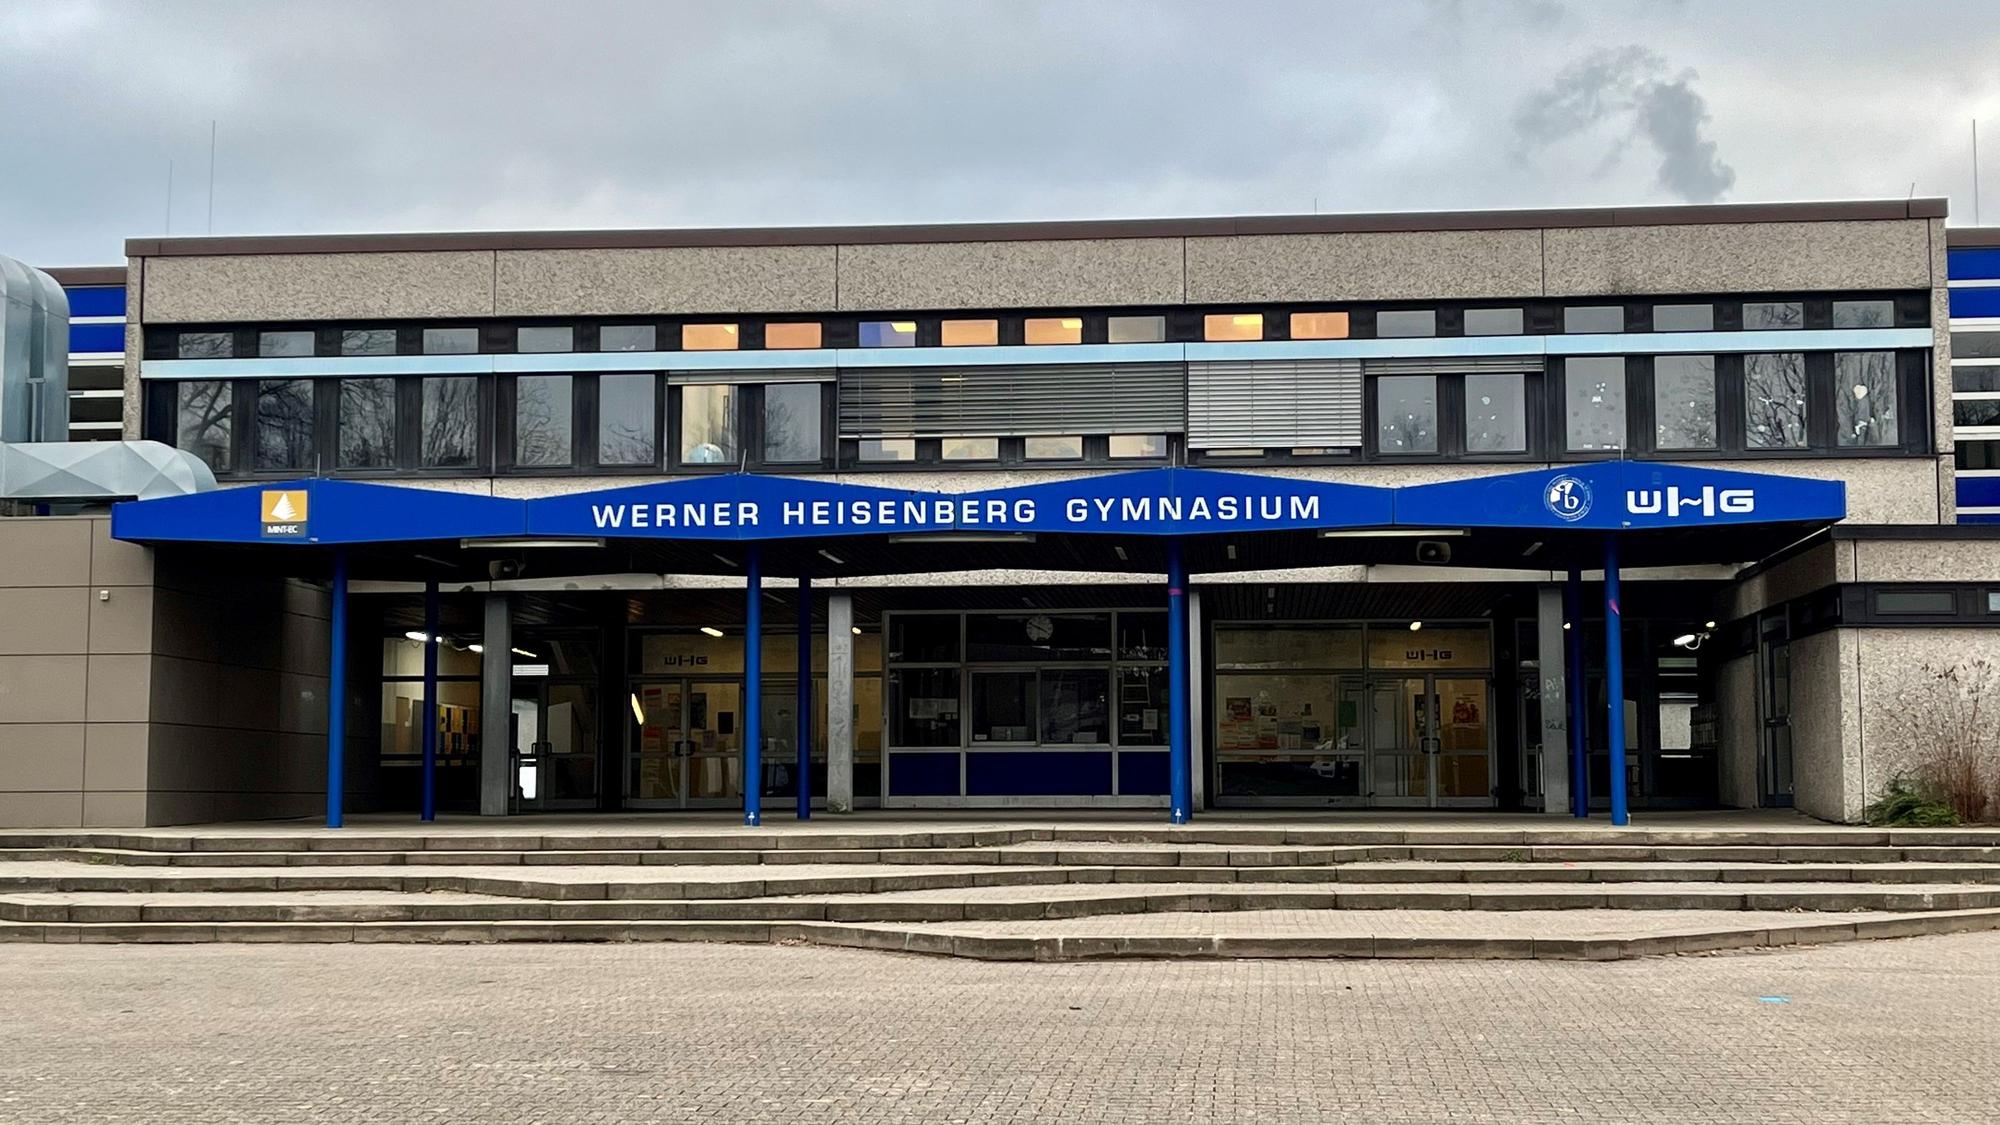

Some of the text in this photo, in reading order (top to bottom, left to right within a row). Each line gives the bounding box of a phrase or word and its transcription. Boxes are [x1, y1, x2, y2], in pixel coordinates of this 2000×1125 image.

[592, 495, 1319, 528] WERNER HEISENBERG GYMNASIUM
